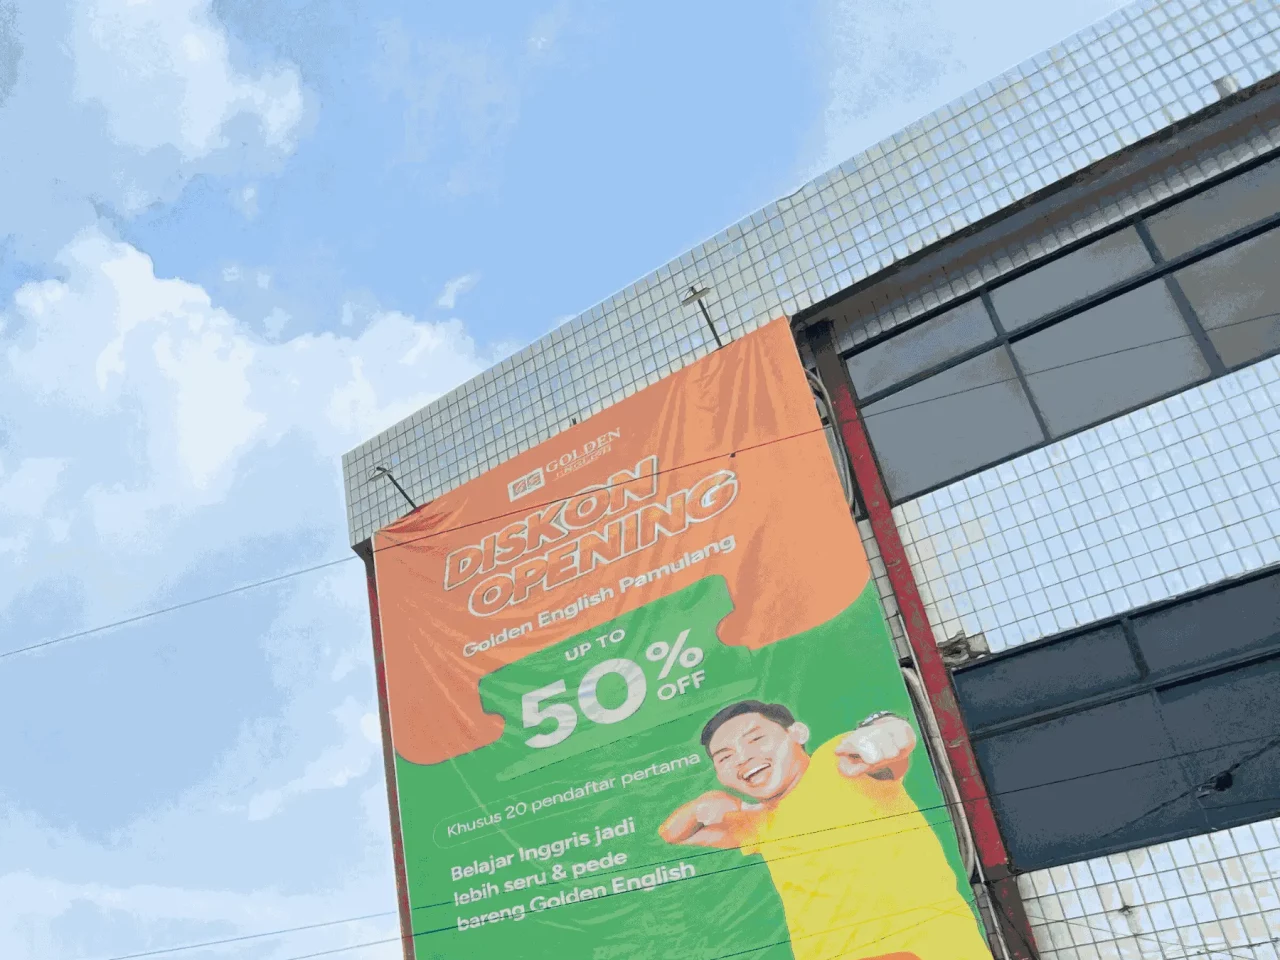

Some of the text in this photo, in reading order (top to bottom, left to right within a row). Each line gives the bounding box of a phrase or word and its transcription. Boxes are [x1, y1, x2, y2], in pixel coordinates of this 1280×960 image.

[546, 427, 620, 472] GOLDEN
[443, 455, 659, 591] DISKON
[468, 469, 738, 617] OPENING
[462, 535, 737, 658] Golden English Pamulang
[564, 629, 626, 662] UP TO
[522, 628, 704, 749] 50%
[657, 670, 706, 701] OFF
[447, 753, 701, 837] Khusus 20 pendaftar pertama
[451, 817, 636, 882] Belajar Inggris jadi
[454, 850, 628, 907] lebih seru & pede
[457, 861, 696, 931] bareng Golden English
